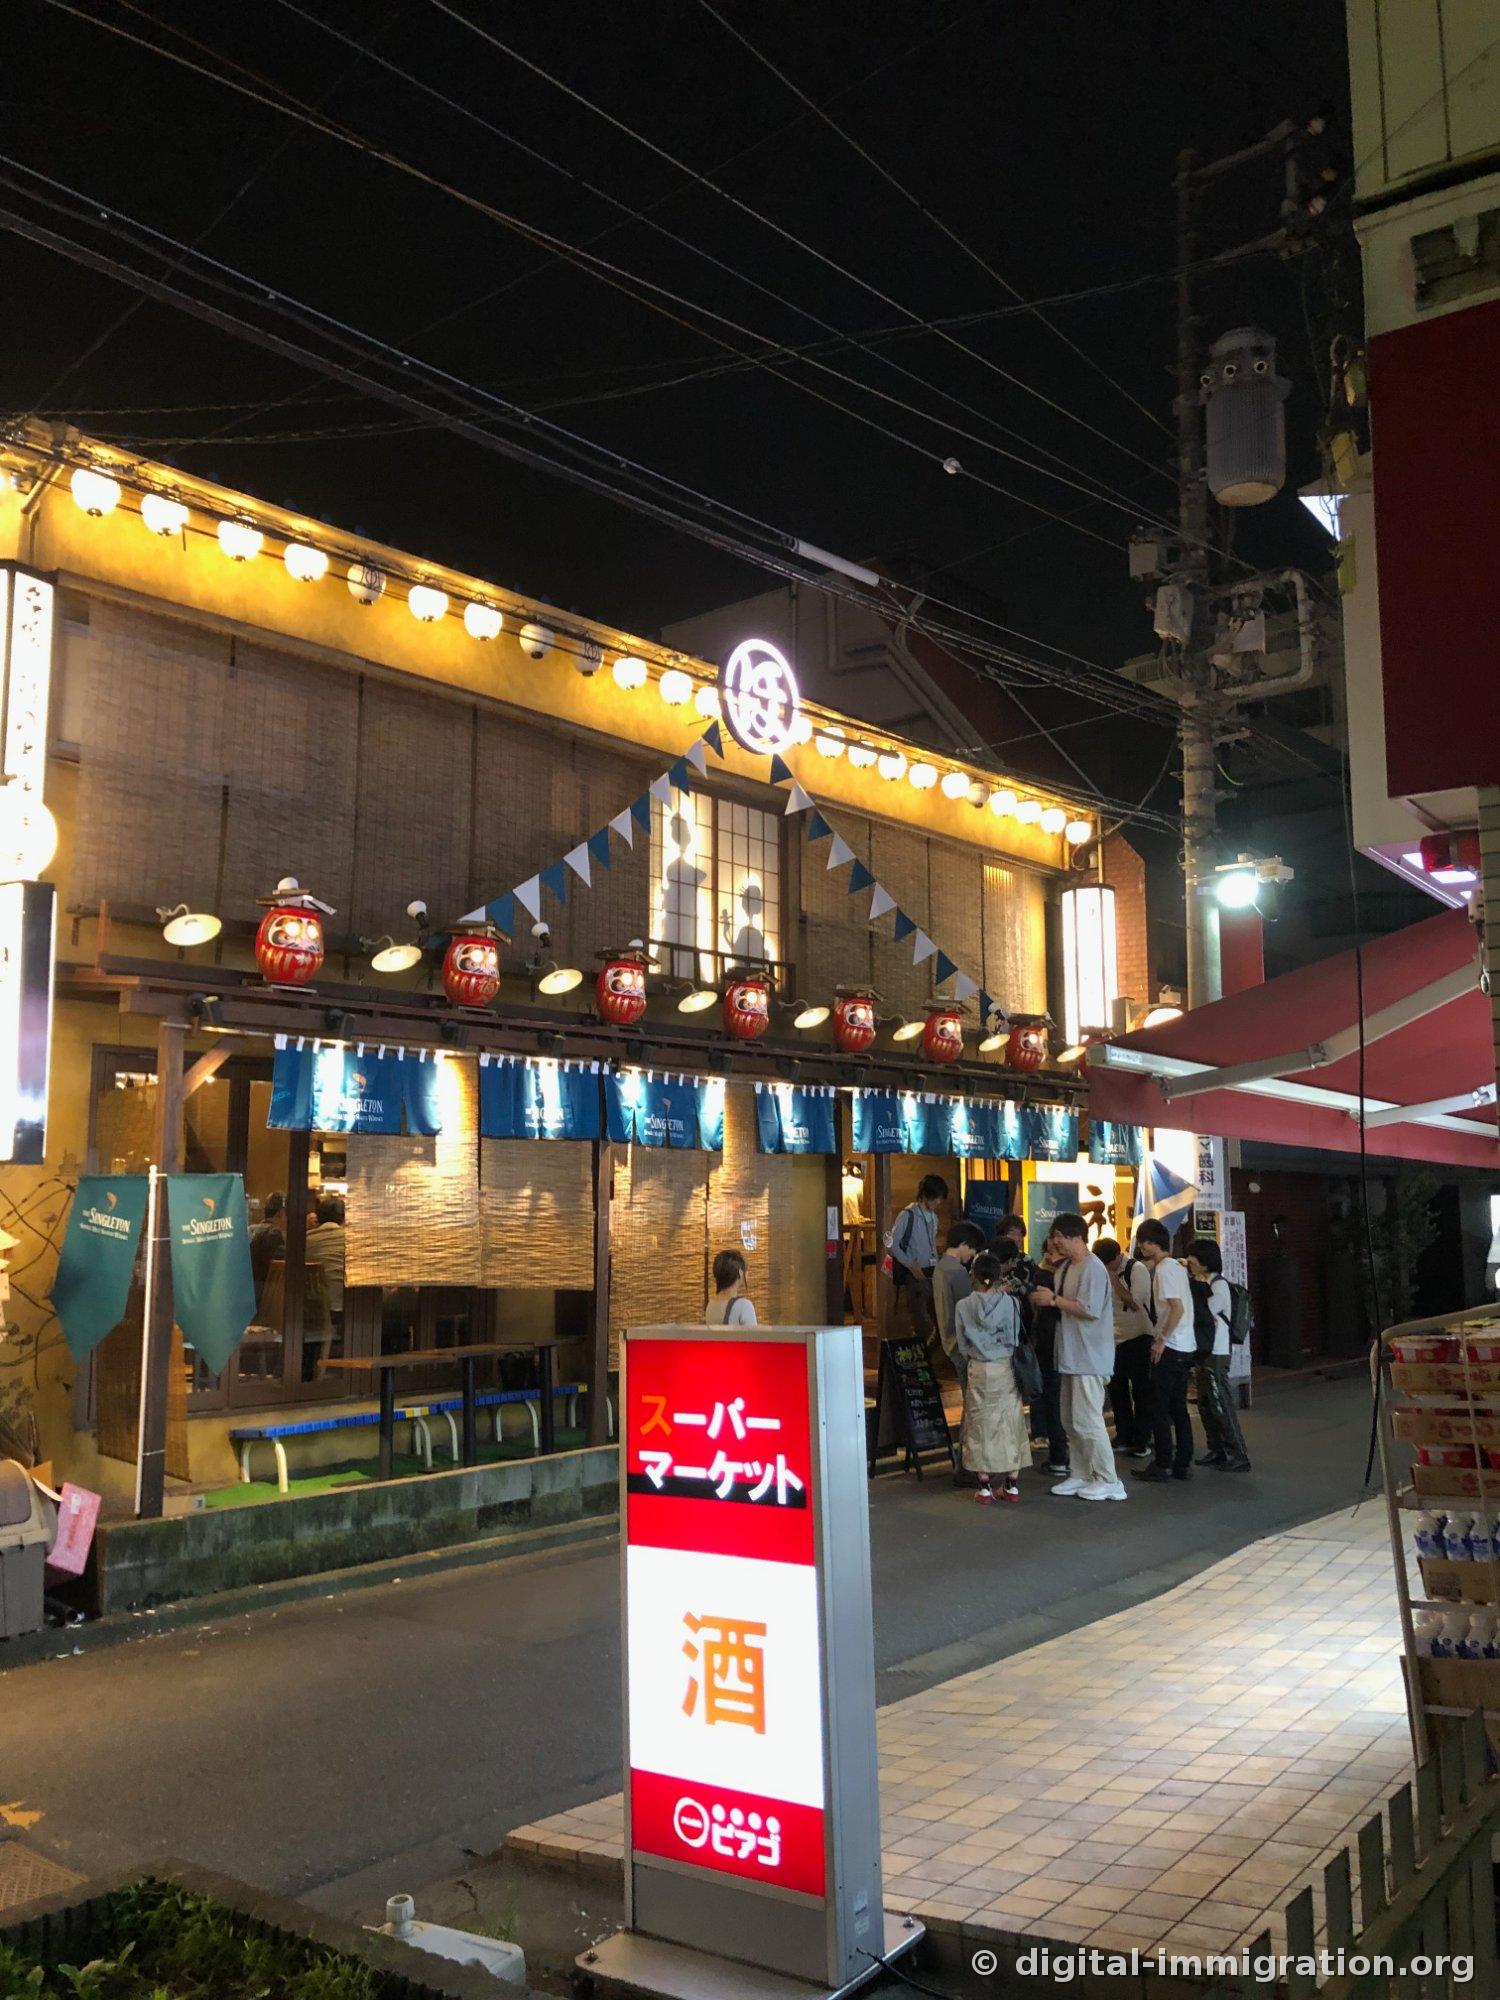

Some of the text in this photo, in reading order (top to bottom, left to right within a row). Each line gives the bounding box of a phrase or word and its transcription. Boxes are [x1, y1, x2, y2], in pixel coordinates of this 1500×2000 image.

[651, 1113, 684, 1131] SINGETON
[89, 1207, 131, 1233] SINGLETON
[190, 1216, 232, 1236] SINGLETON
[639, 1394, 781, 1440] スーパー
[638, 1449, 803, 1507] マーケット
[681, 1610, 768, 1736] 酒
[711, 1821, 781, 1867] ピアゴ
